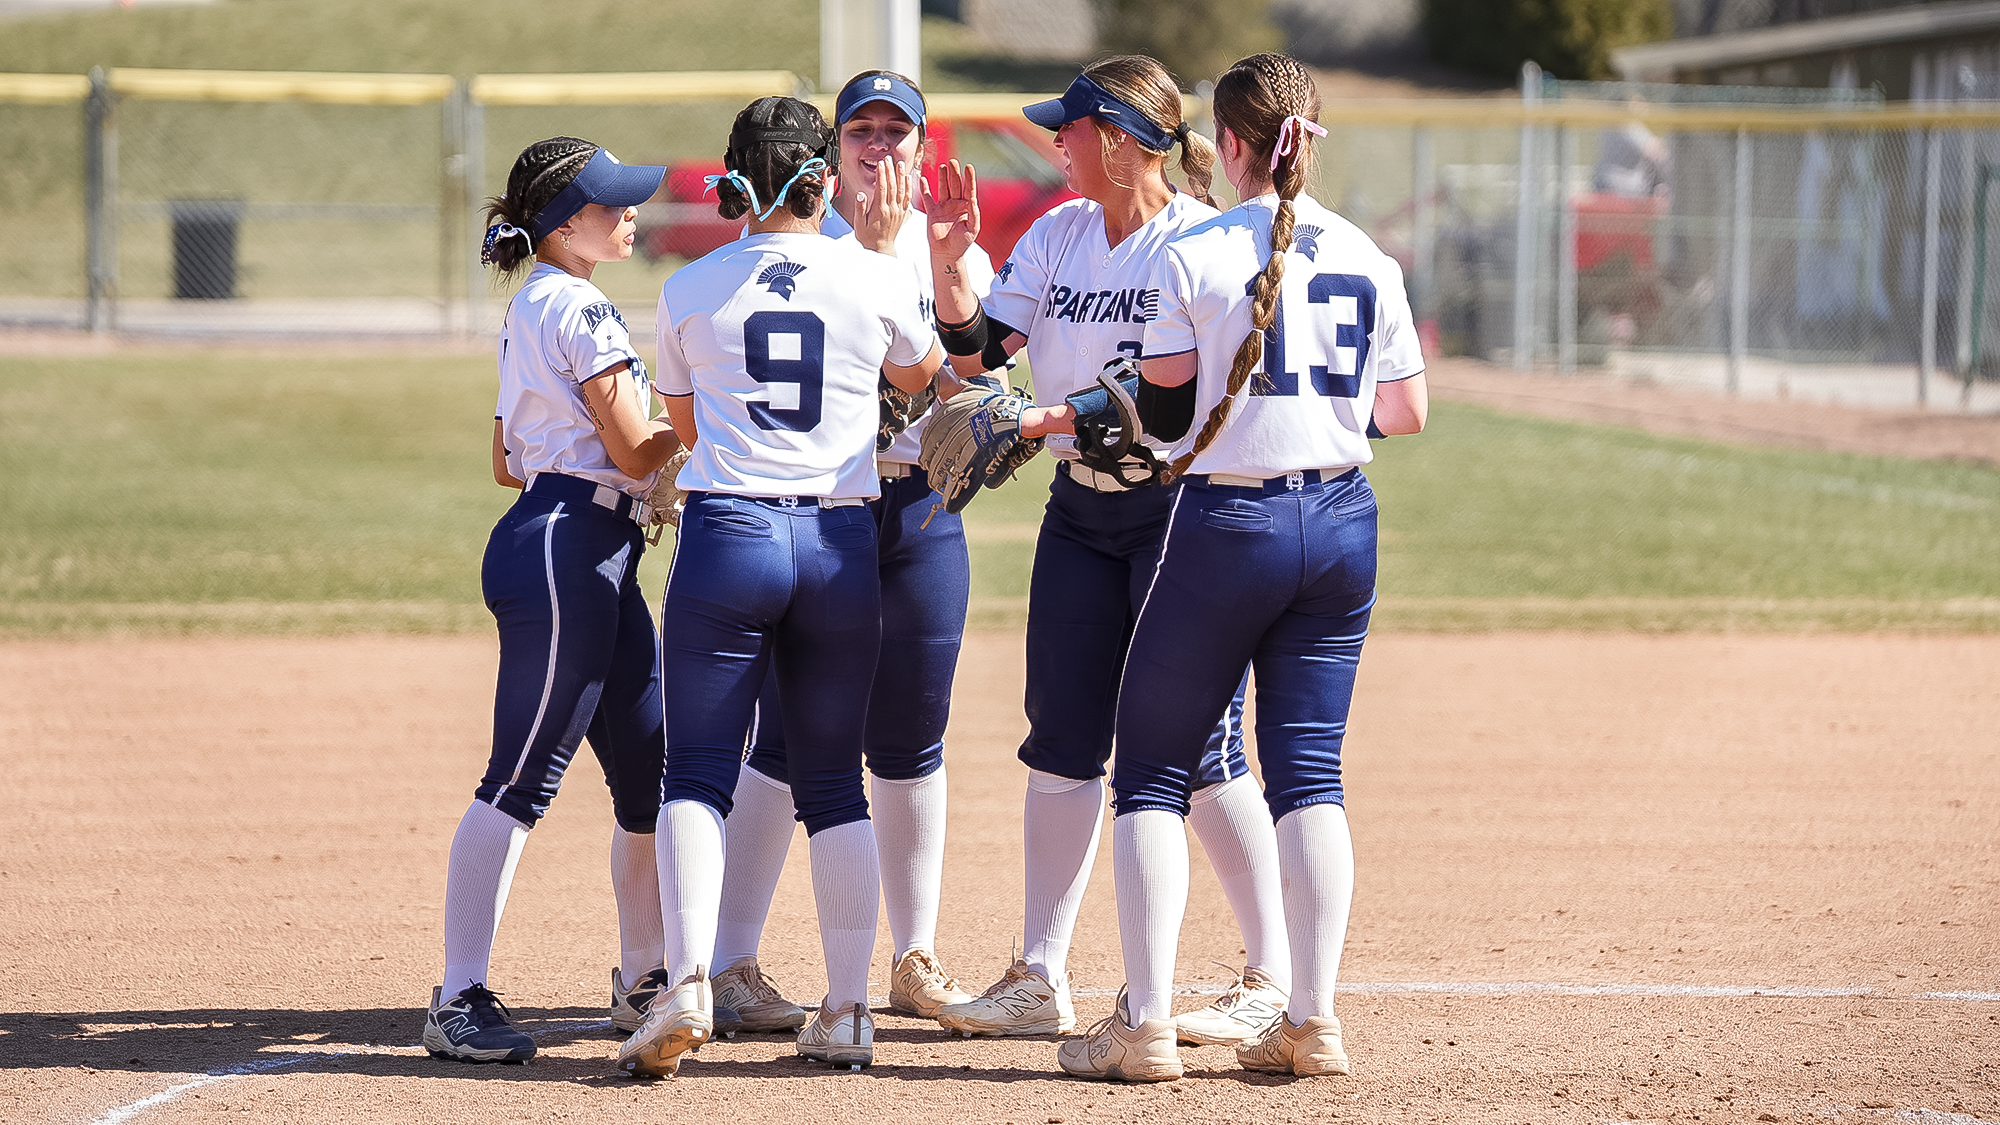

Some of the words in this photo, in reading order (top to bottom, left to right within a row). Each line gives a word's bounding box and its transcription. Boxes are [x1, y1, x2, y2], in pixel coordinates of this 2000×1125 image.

[1045, 283, 1146, 324] SPARTANS
[1245, 272, 1377, 398] 13
[743, 311, 825, 433] 9
